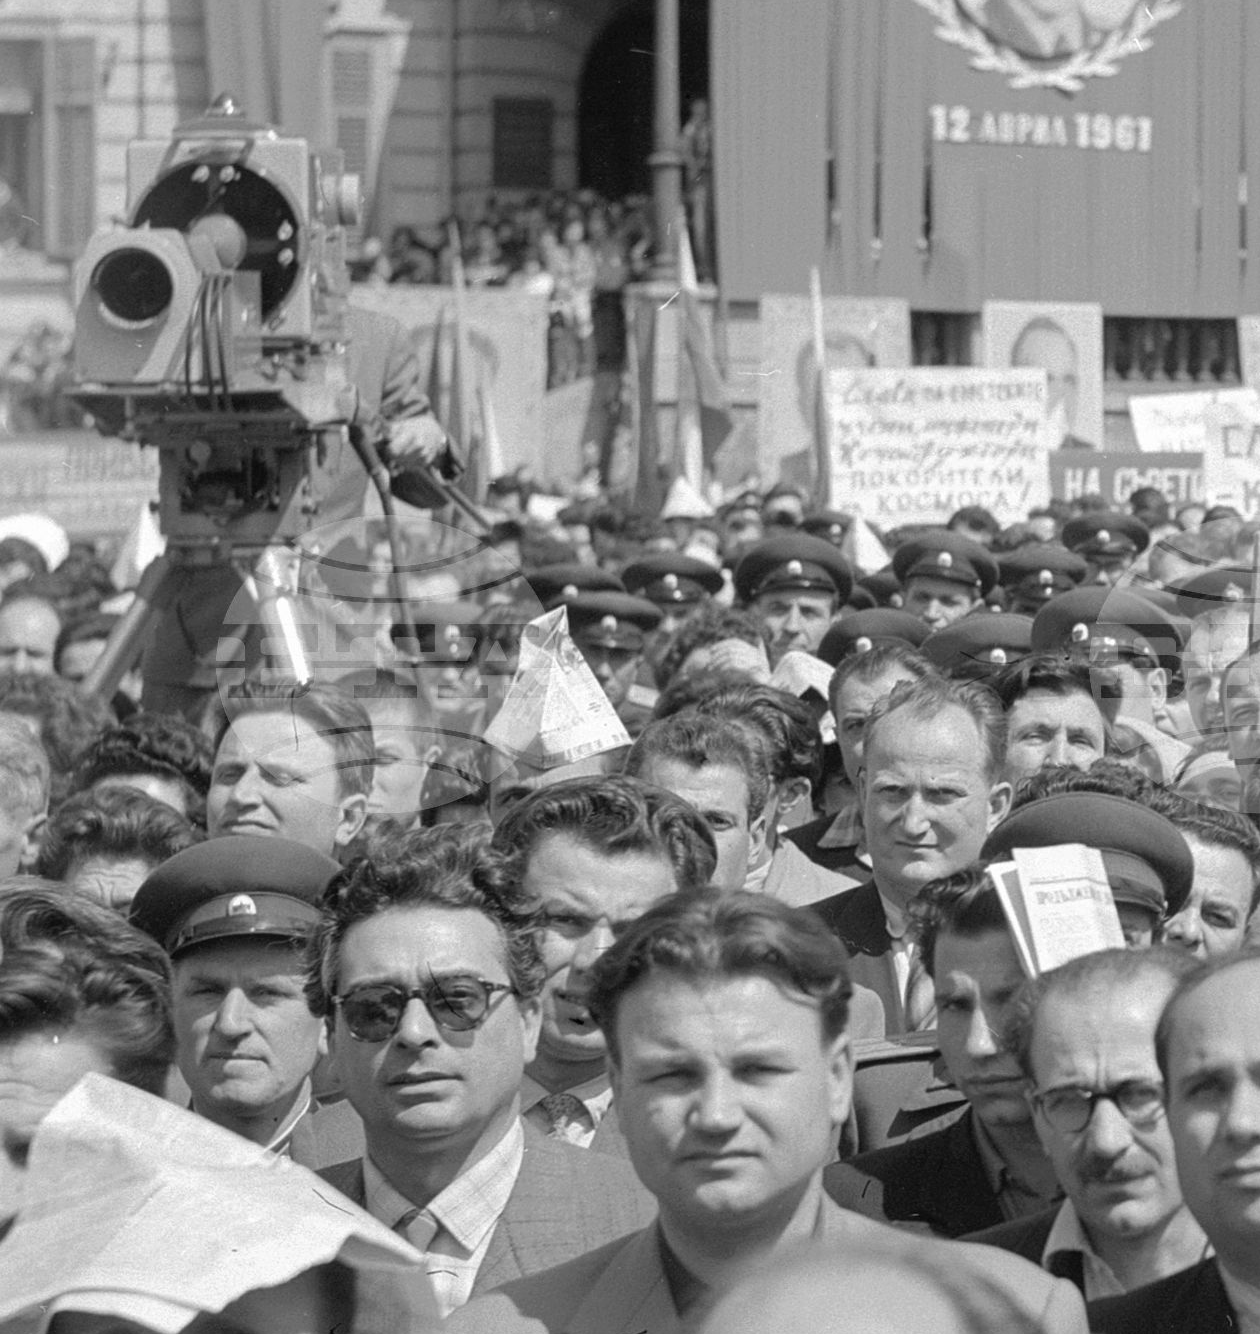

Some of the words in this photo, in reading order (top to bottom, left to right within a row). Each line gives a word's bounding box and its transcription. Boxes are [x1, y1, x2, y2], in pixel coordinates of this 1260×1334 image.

[928, 103, 971, 143] 12
[1073, 112, 1153, 152] 1961
[1063, 467, 1100, 503] НА
